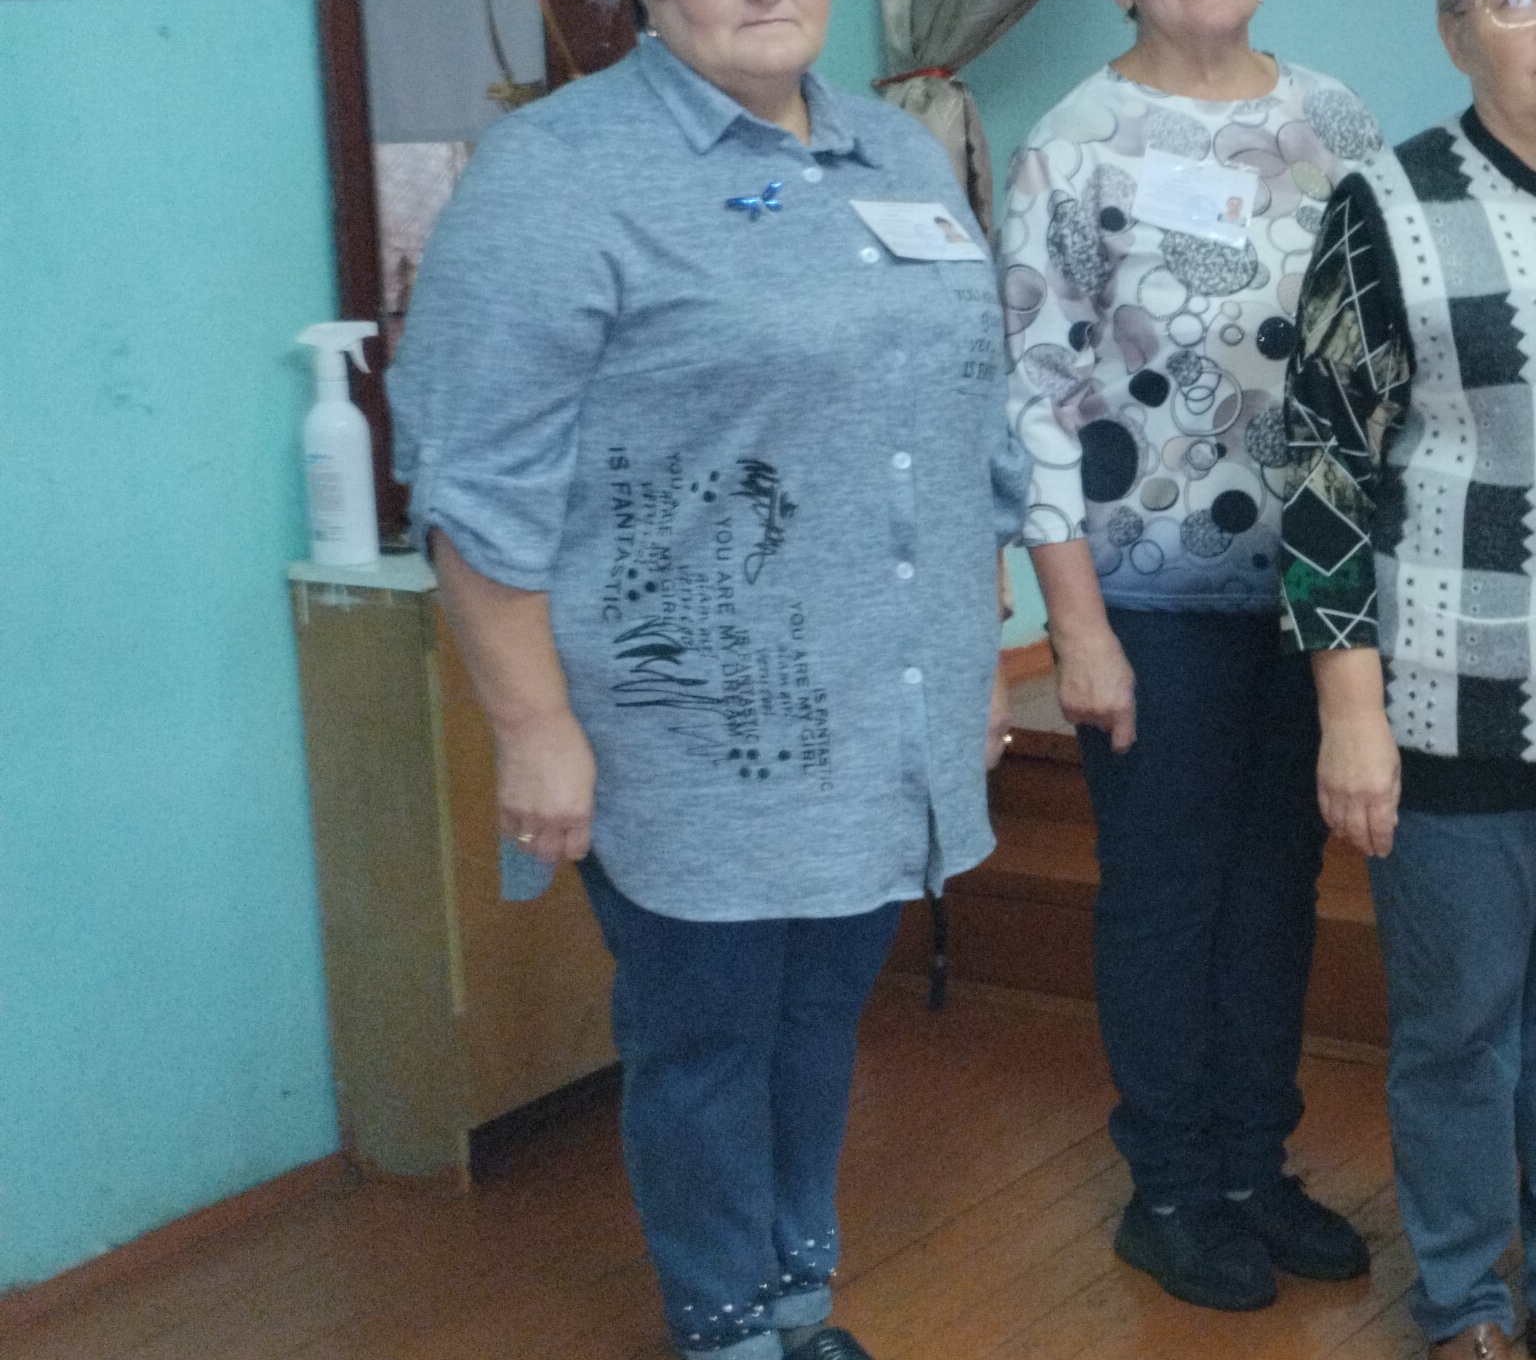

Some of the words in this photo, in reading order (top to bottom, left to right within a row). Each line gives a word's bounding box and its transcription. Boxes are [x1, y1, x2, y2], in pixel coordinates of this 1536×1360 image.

[608, 447, 630, 470] IS
[602, 481, 635, 622] FANTASTIC
[715, 518, 733, 561] YOU
[717, 571, 735, 614] ARE
[790, 602, 804, 640] YOU
[794, 651, 810, 688] ARE
[813, 688, 828, 703] IS
[816, 708, 834, 790] FANTASTIC
